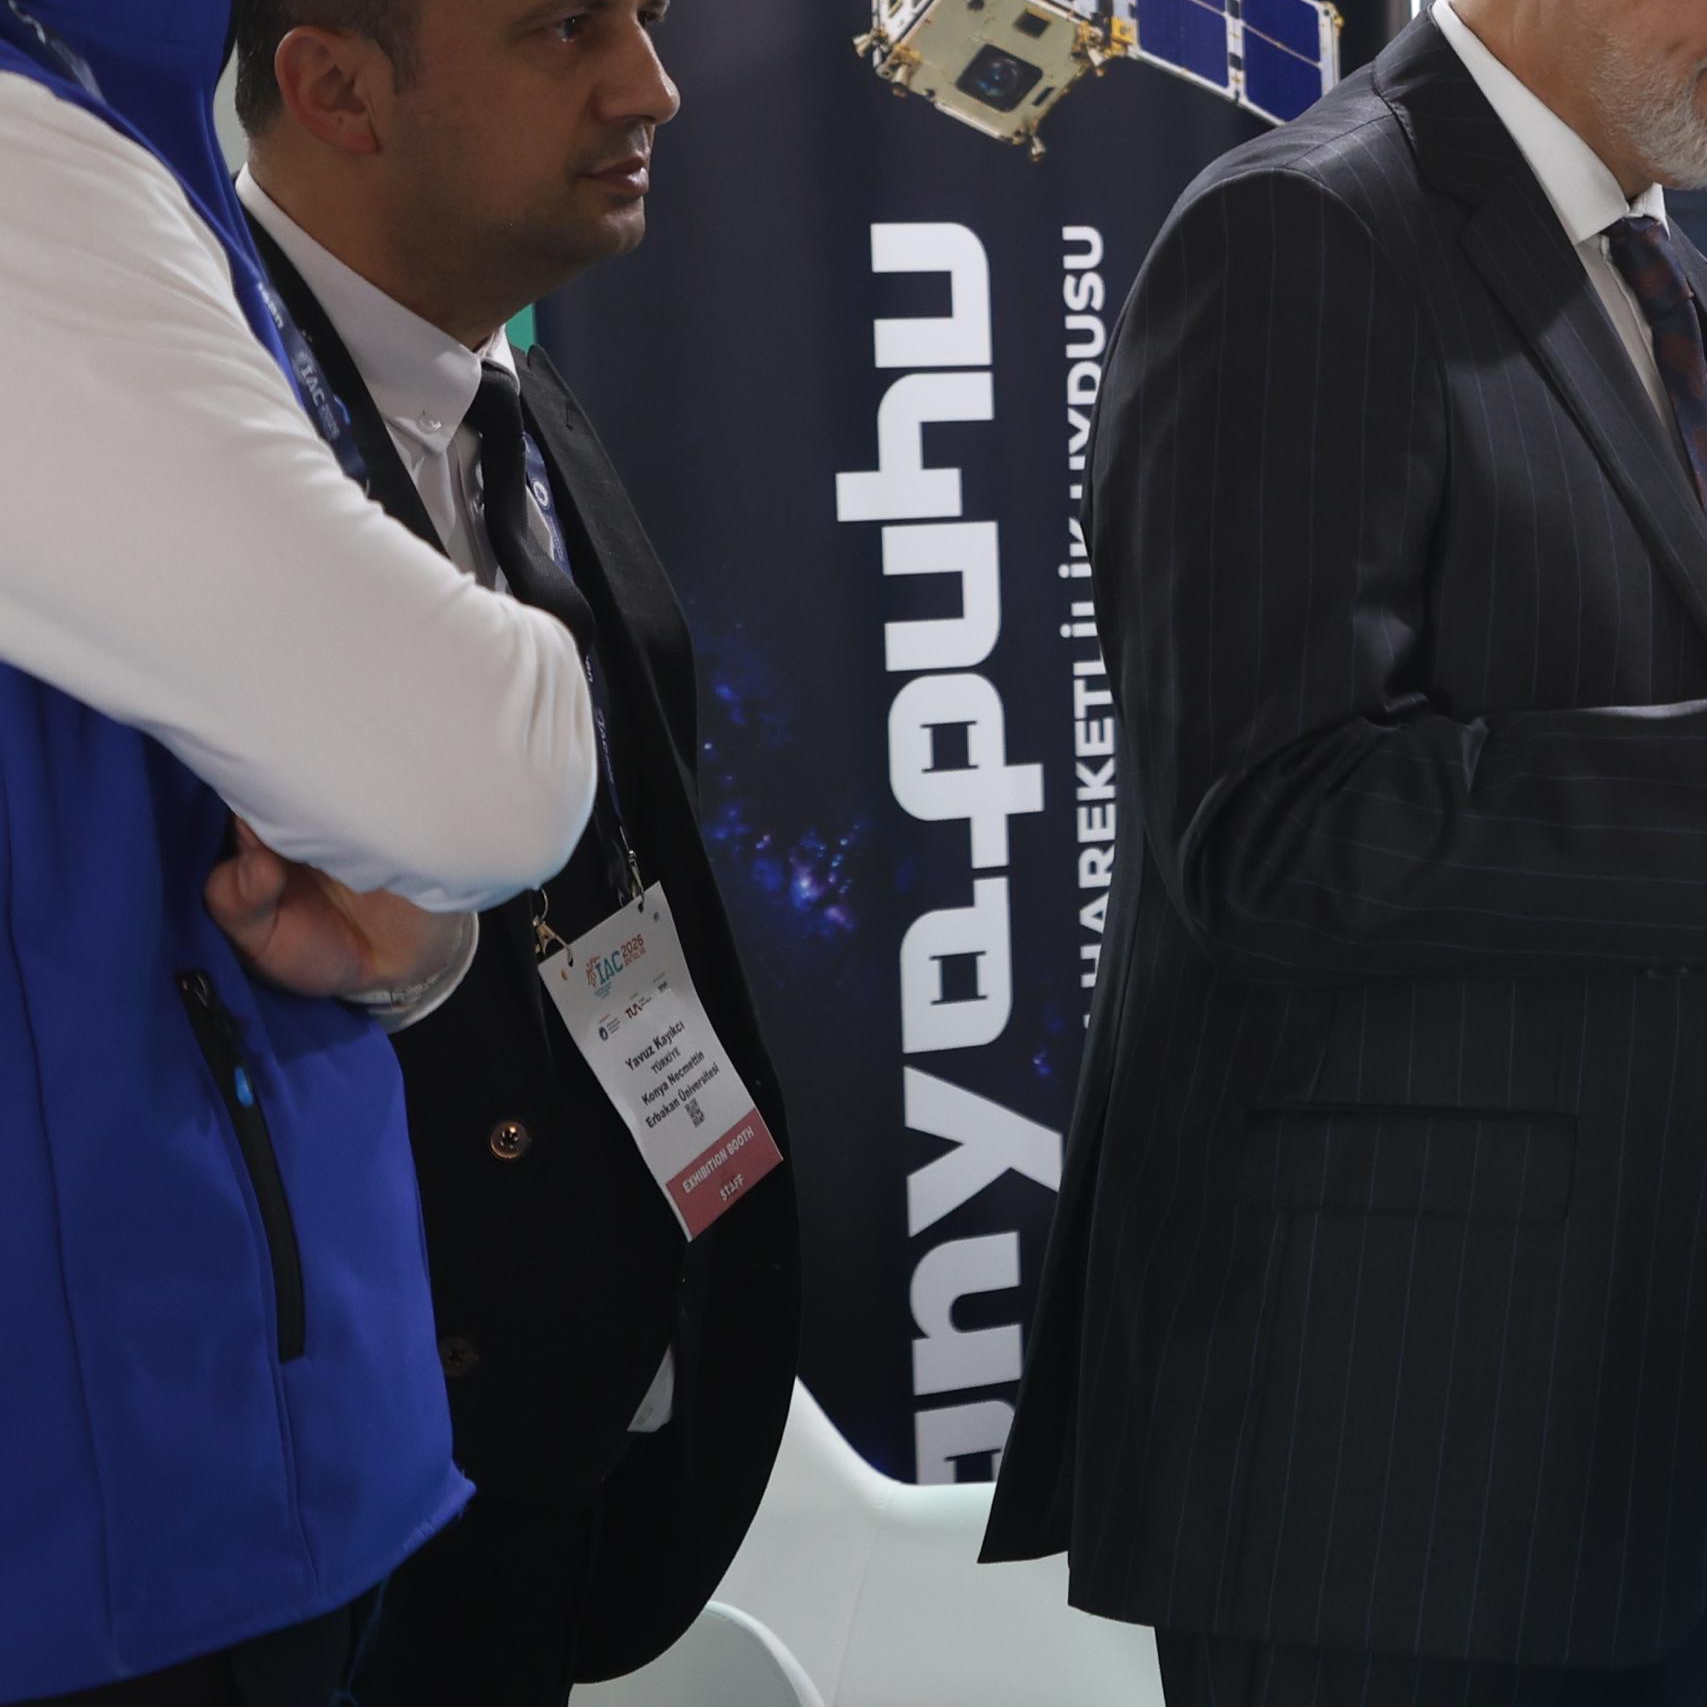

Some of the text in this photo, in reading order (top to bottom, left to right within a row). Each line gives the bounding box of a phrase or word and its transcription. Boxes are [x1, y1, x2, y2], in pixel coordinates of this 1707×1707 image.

[597, 950, 624, 984] IAC
[620, 934, 645, 959] 2026
[625, 1044, 655, 1071] Yavuz
[641, 1051, 705, 1106] Konya Necmettin
[645, 1098, 680, 1129] Erbakan
[682, 1126, 755, 1194] EXHIBITION BOOTH
[720, 1173, 745, 1202] STAFF
